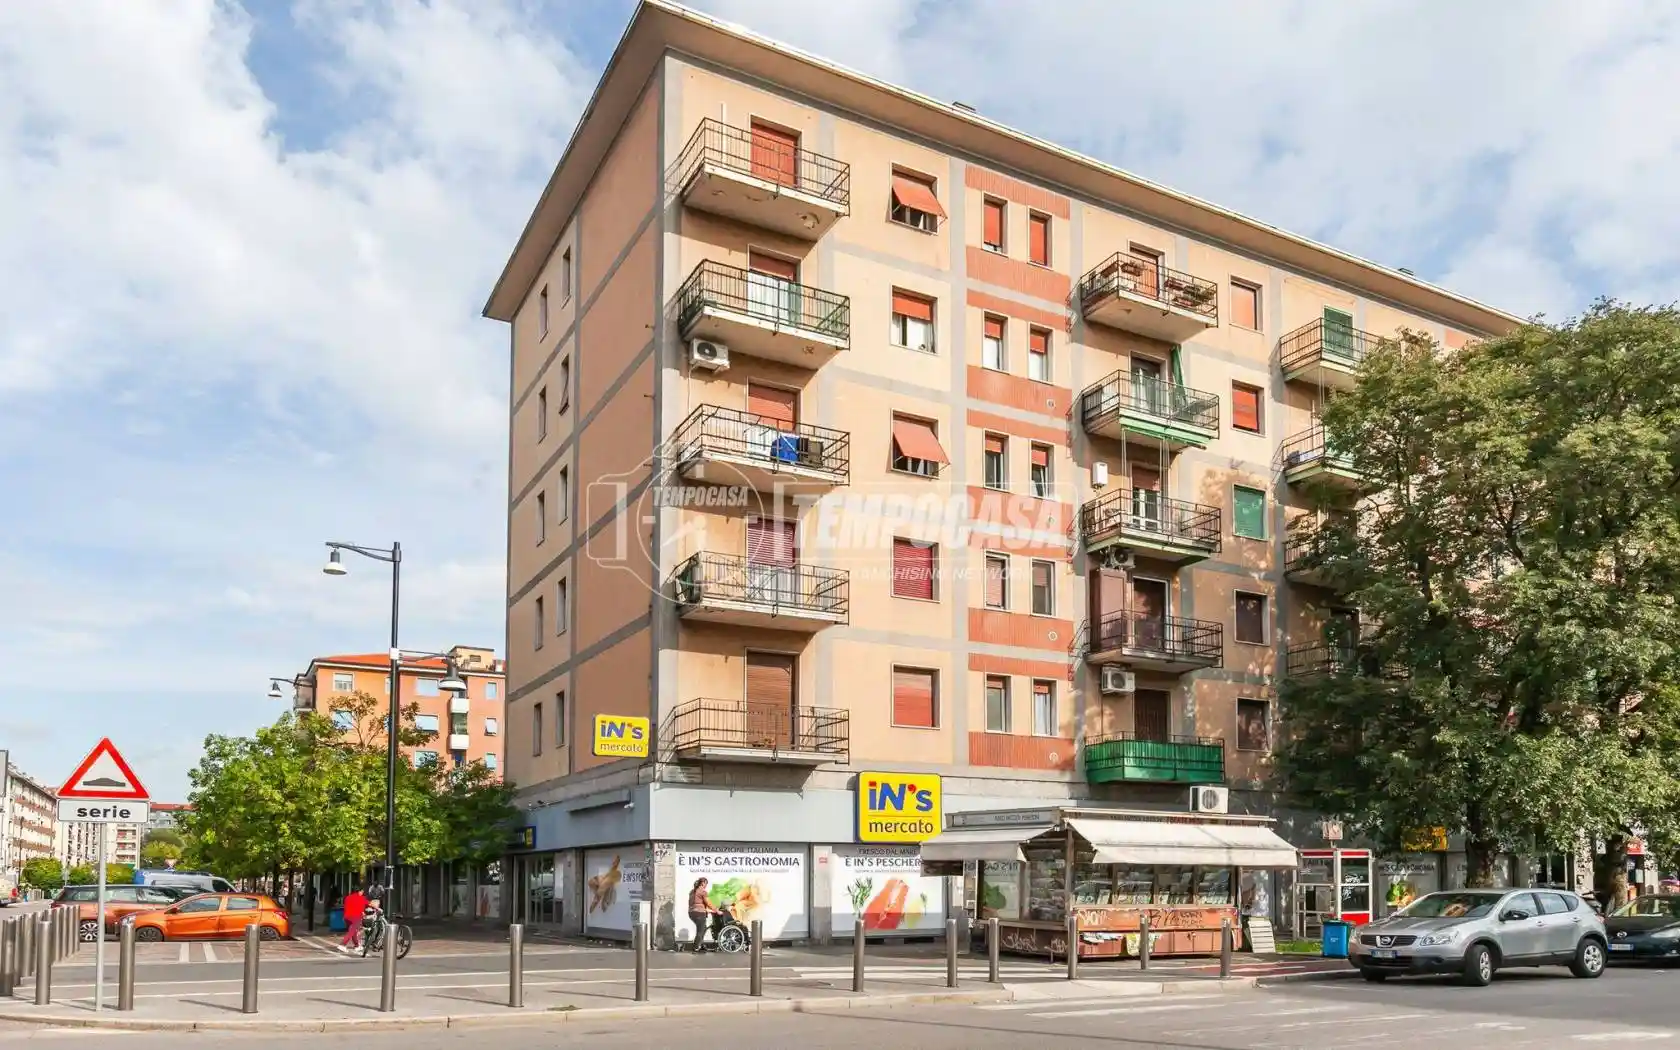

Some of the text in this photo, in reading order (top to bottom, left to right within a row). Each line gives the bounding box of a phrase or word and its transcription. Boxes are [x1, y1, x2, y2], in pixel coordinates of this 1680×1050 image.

[600, 743, 643, 752] mercato
[77, 805, 131, 818] serie
[869, 819, 934, 833] mercato
[688, 856, 711, 866] IN'S
[714, 856, 800, 867] GASTRONOMIA
[854, 857, 873, 866] IN'S
[876, 858, 921, 867] PESCHER
